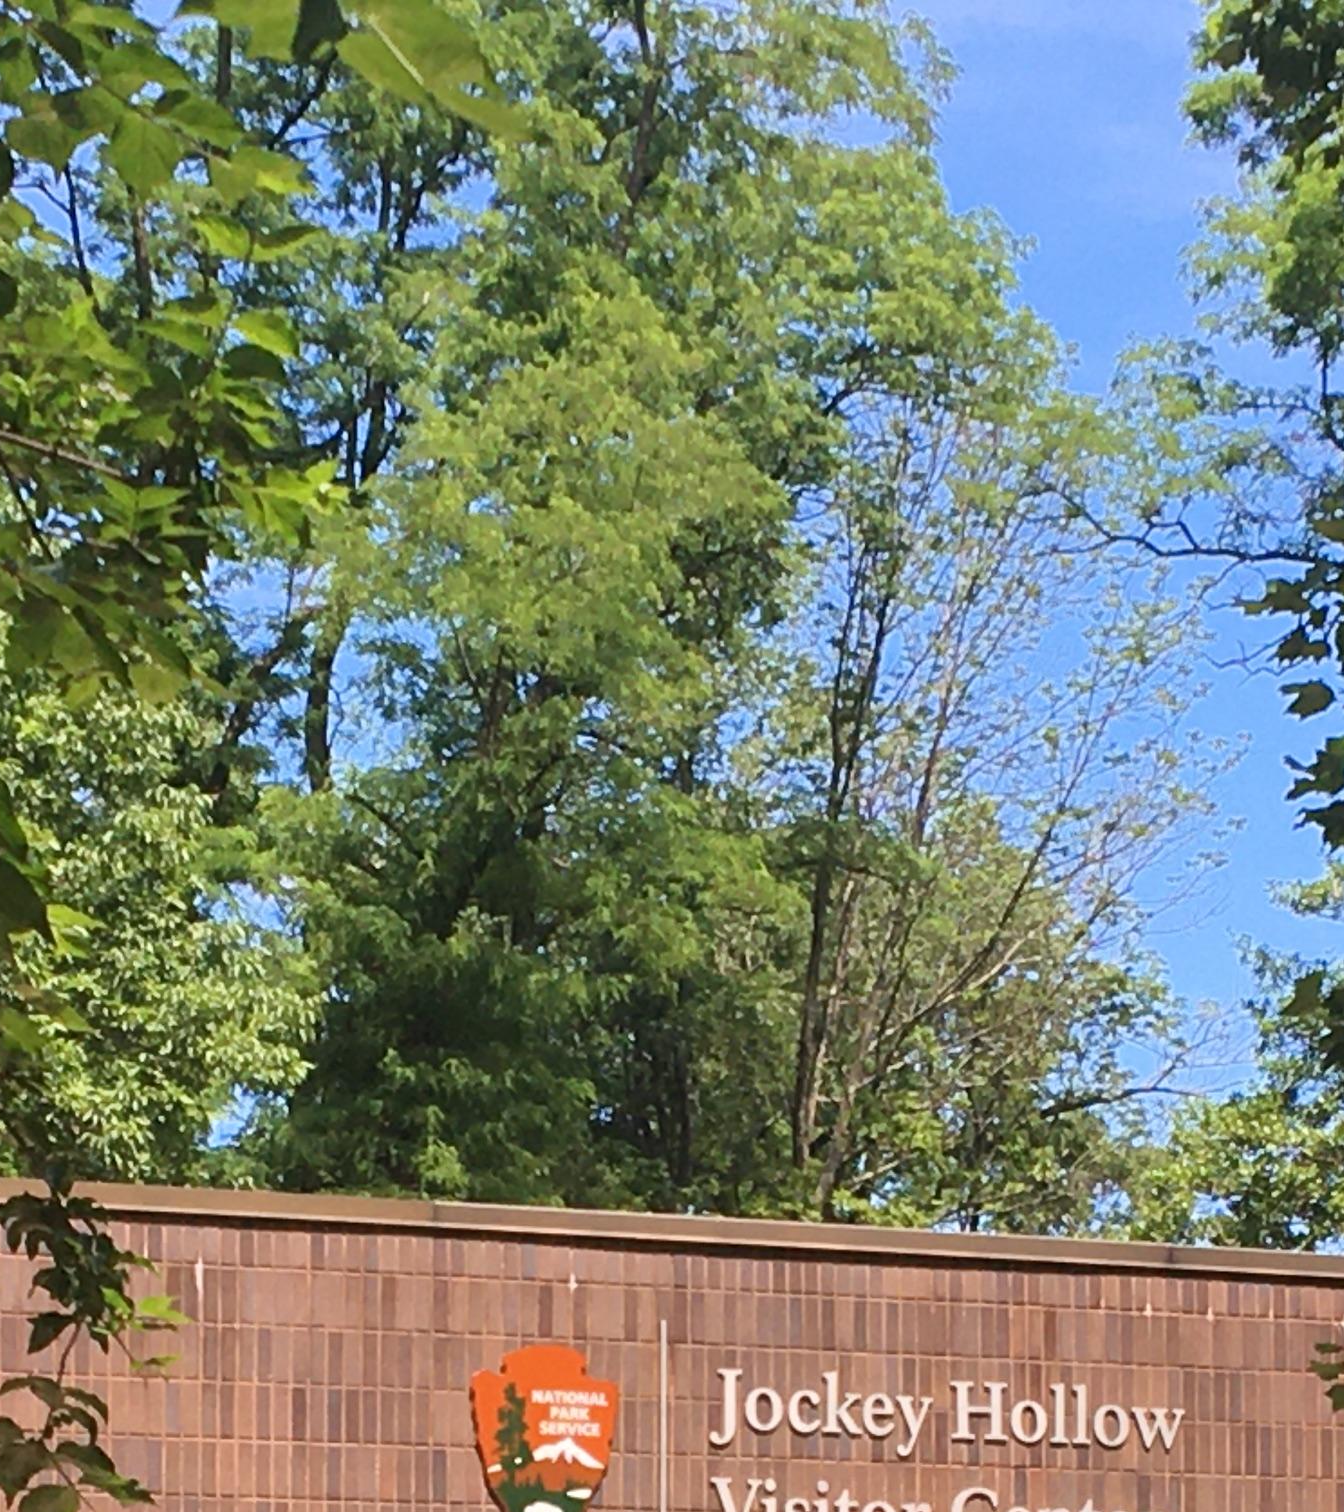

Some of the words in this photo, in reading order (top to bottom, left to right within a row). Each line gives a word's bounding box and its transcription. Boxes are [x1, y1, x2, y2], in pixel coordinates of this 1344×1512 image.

[531, 1390, 608, 1406] NATIONAL
[550, 1406, 590, 1420] PARK
[709, 1368, 934, 1457] Jockey
[950, 1381, 1186, 1450] Hollow
[539, 1421, 601, 1437] SERVICE
